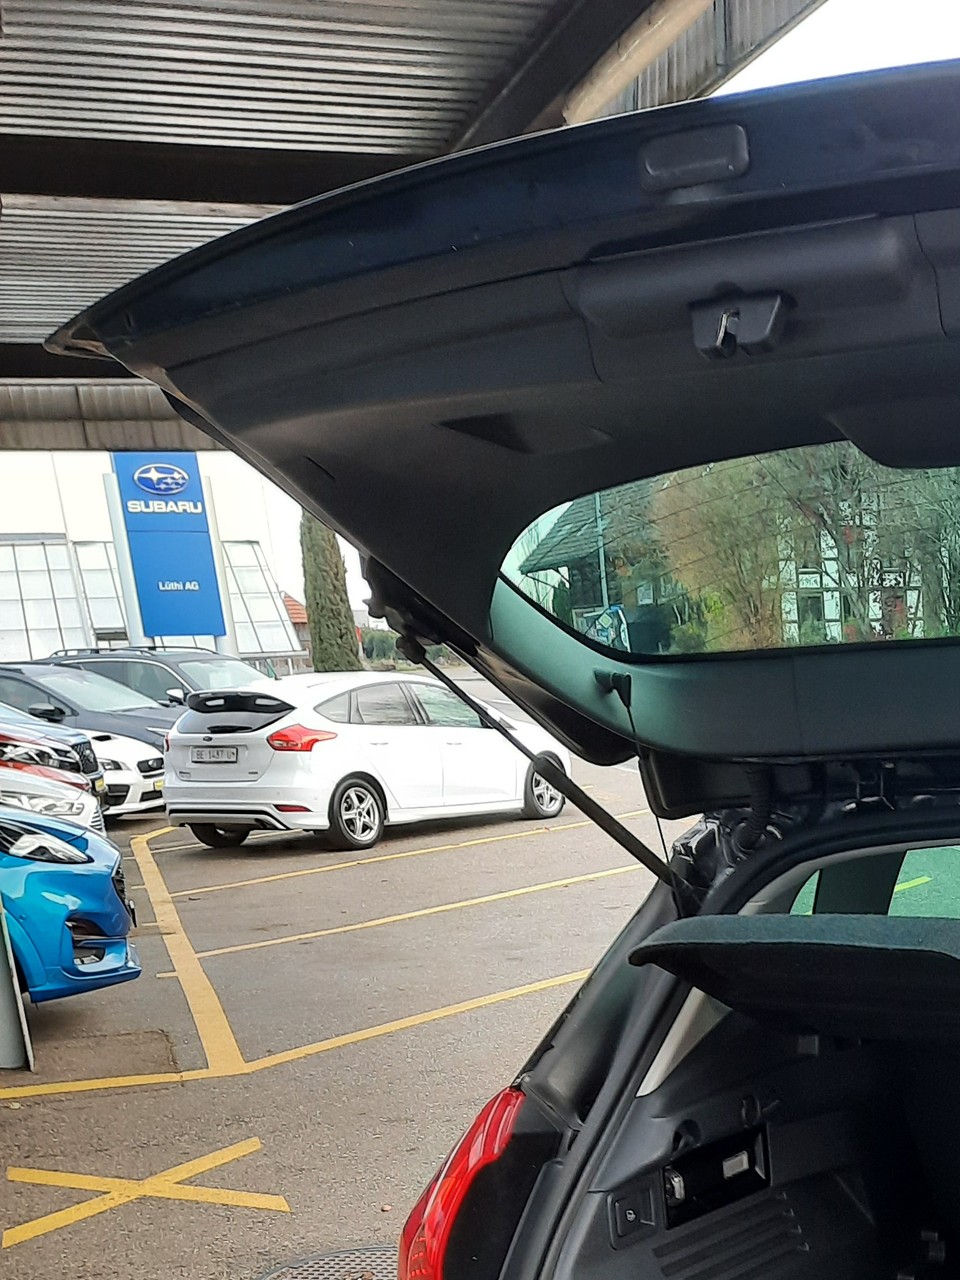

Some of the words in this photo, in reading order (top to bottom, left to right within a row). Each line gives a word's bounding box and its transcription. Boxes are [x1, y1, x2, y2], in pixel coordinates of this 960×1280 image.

[126, 500, 203, 513] SUBARU
[158, 580, 183, 591] Lüthi
[185, 581, 200, 591] AG
